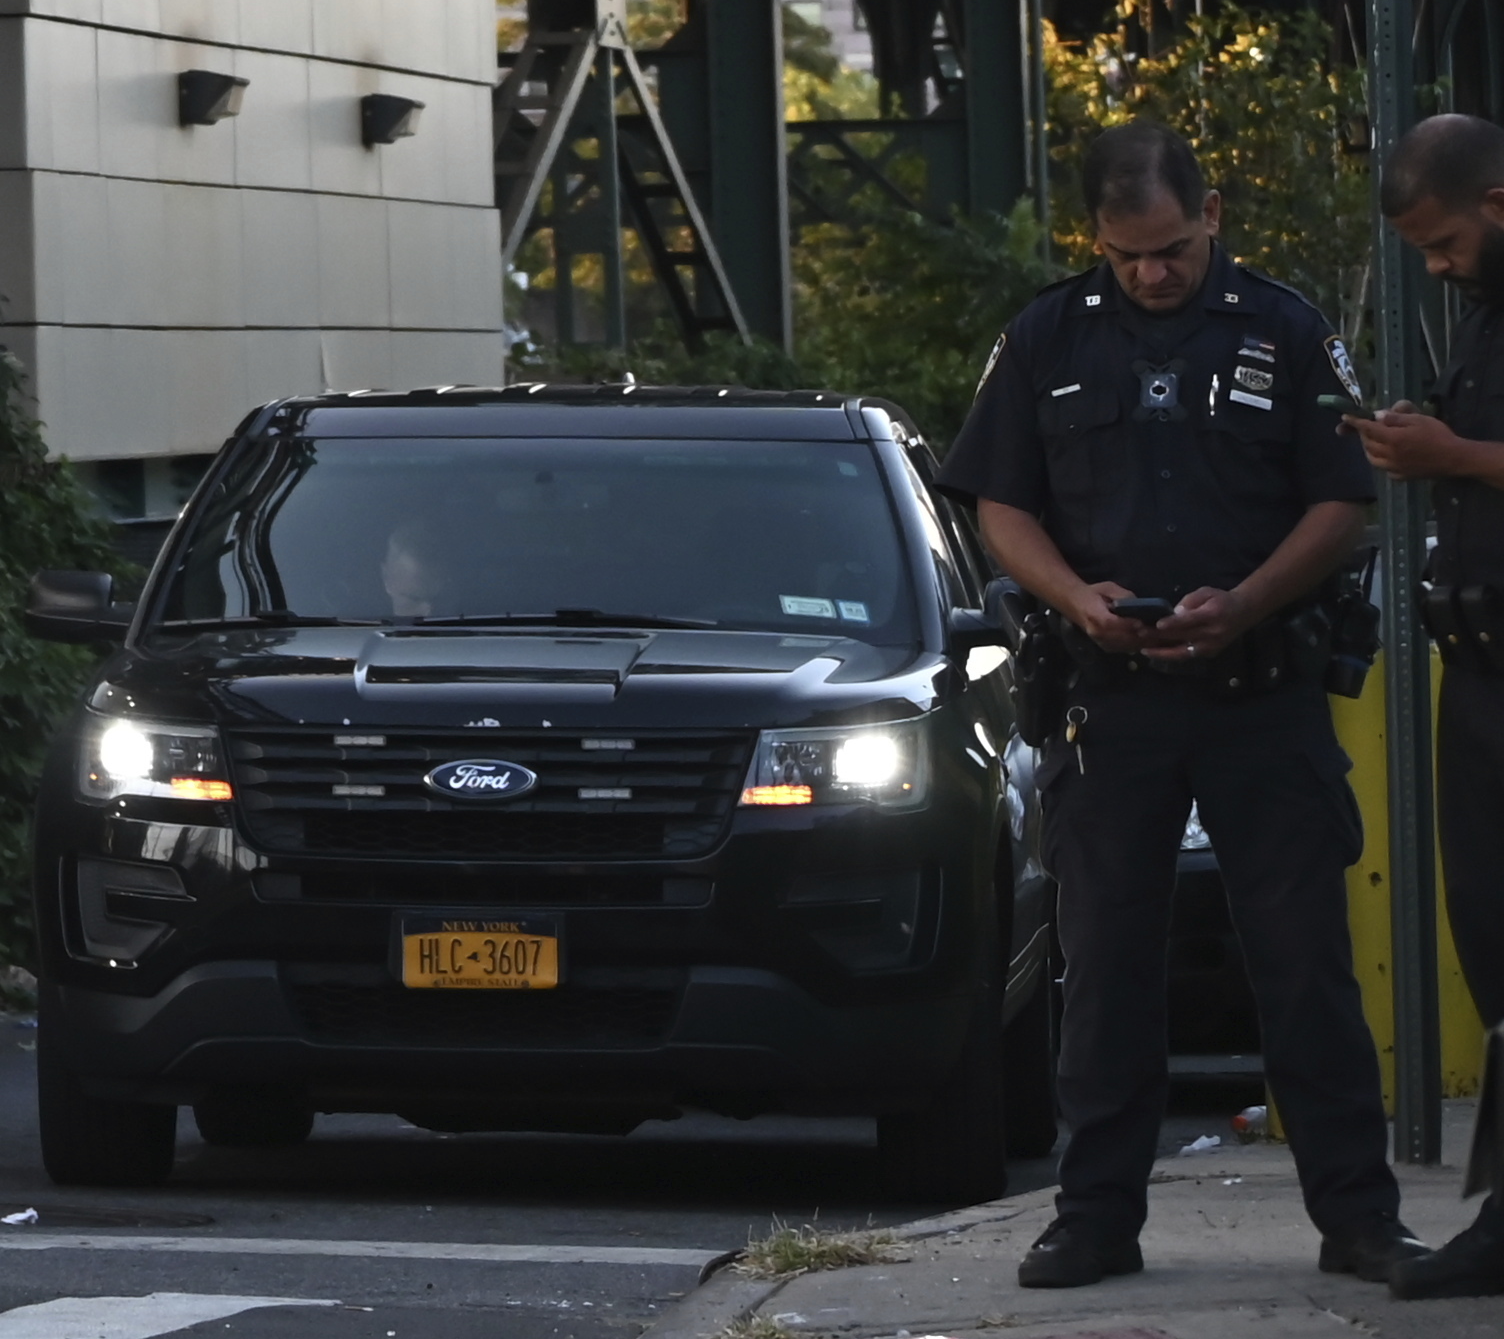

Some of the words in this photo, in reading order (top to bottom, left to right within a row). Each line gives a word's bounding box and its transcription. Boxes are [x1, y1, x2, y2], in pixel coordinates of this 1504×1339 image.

[450, 765, 510, 789] Ford
[442, 922, 478, 932] NEW
[482, 922, 519, 932] YORK
[419, 938, 463, 975] HLC
[483, 939, 542, 976] 3607
